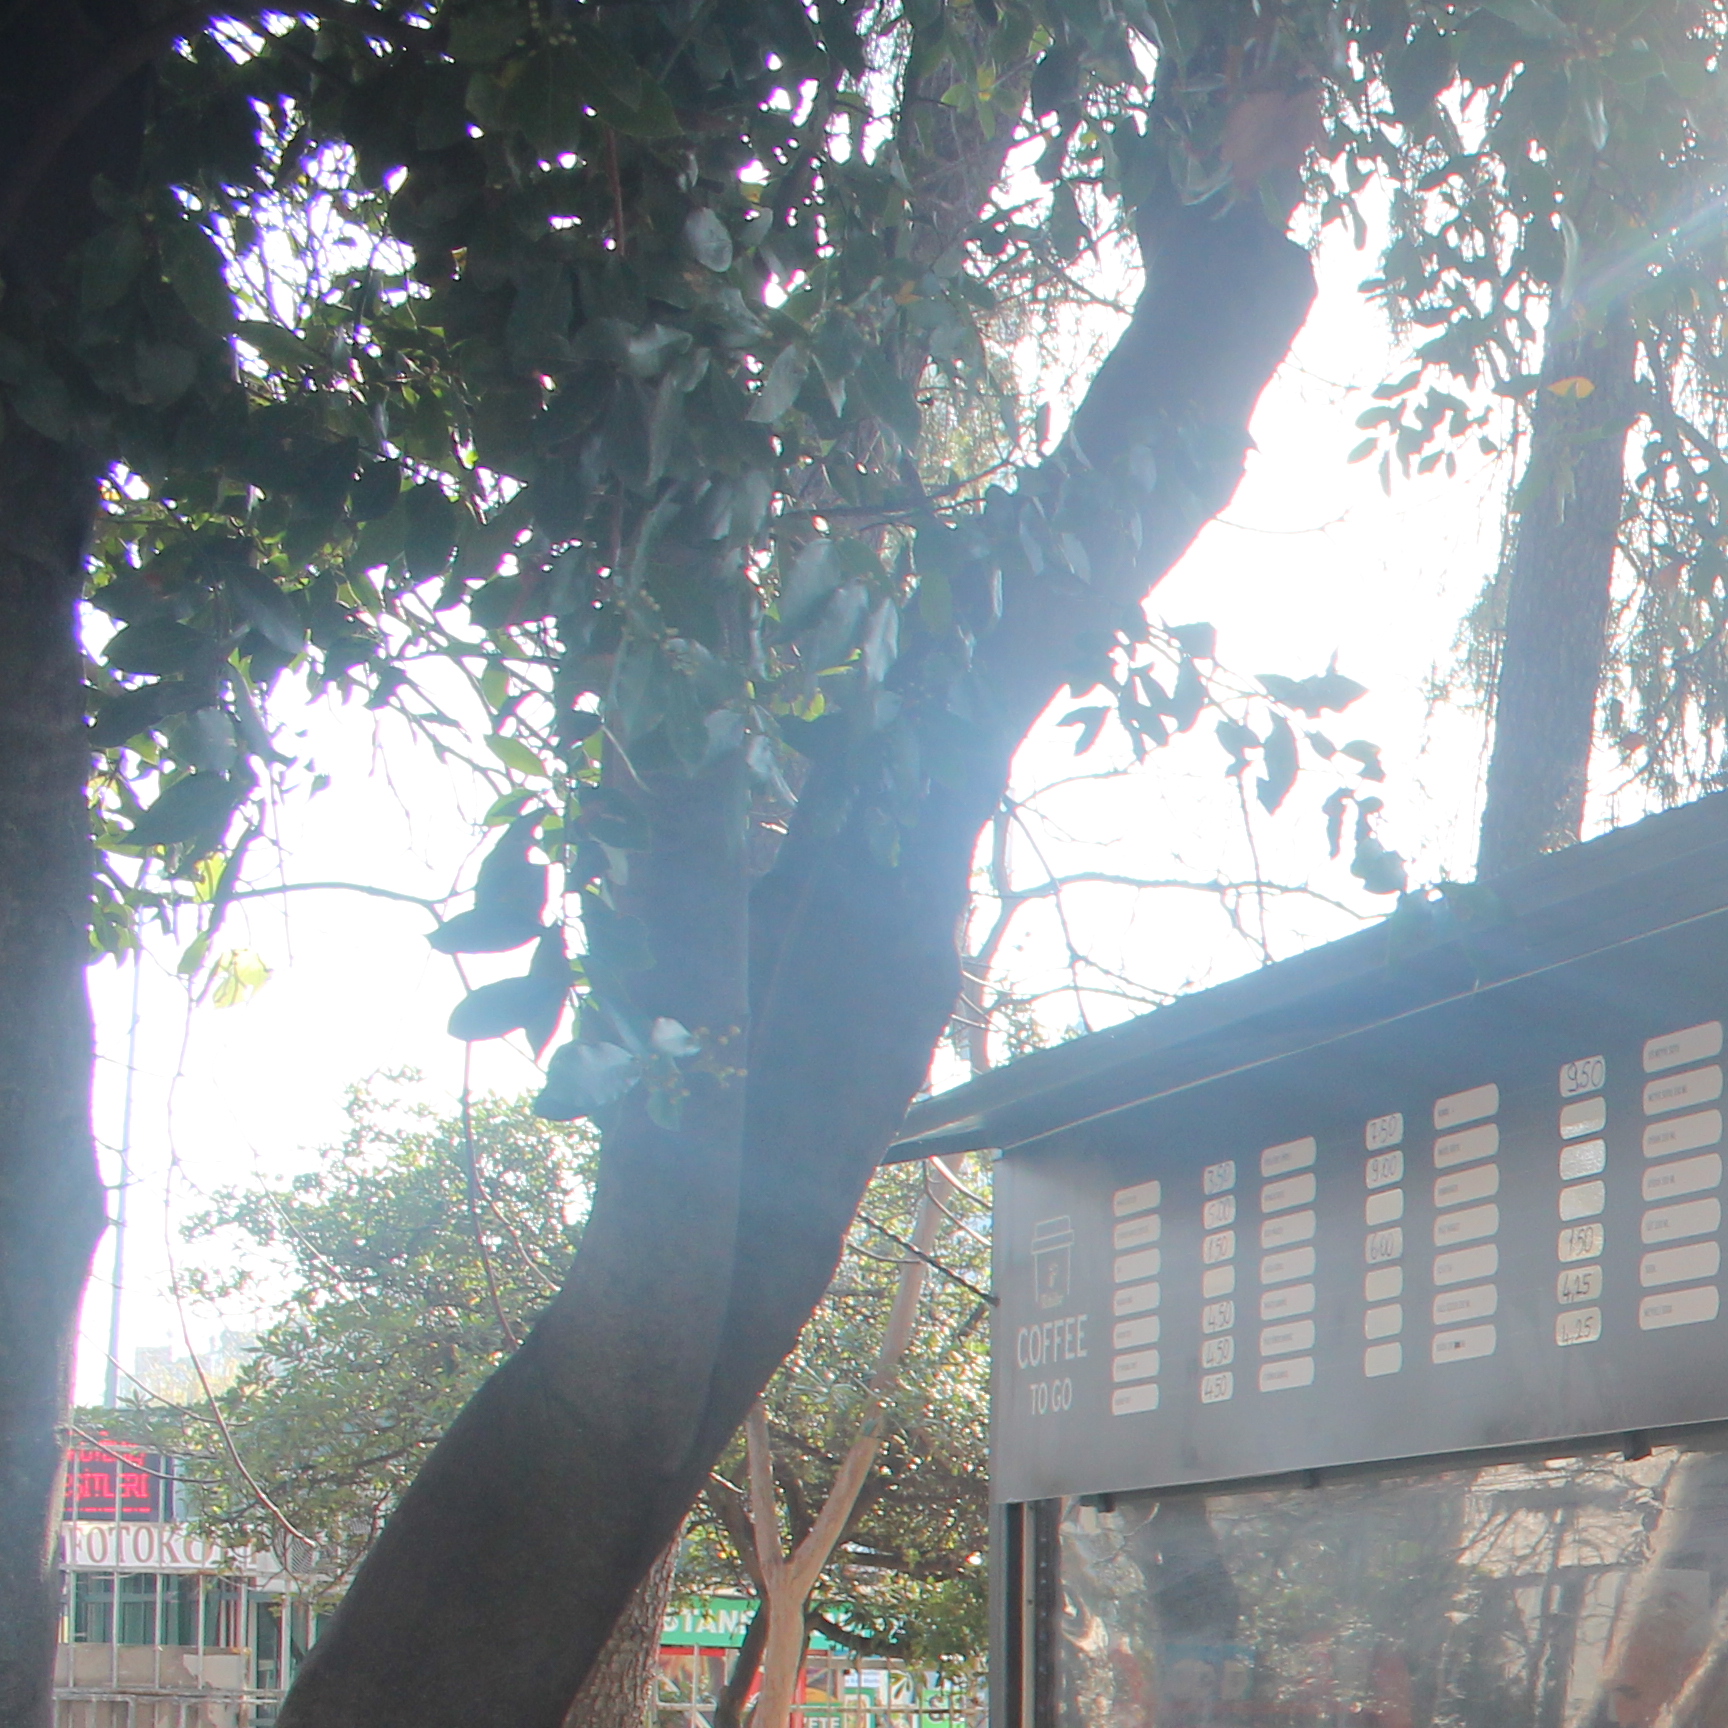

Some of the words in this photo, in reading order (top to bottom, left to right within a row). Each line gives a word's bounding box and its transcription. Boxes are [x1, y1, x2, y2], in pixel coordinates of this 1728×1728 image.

[1018, 1314, 1088, 1369] COFFEE
[1030, 1382, 1048, 1415] TO
[1053, 1378, 1072, 1412] GO
